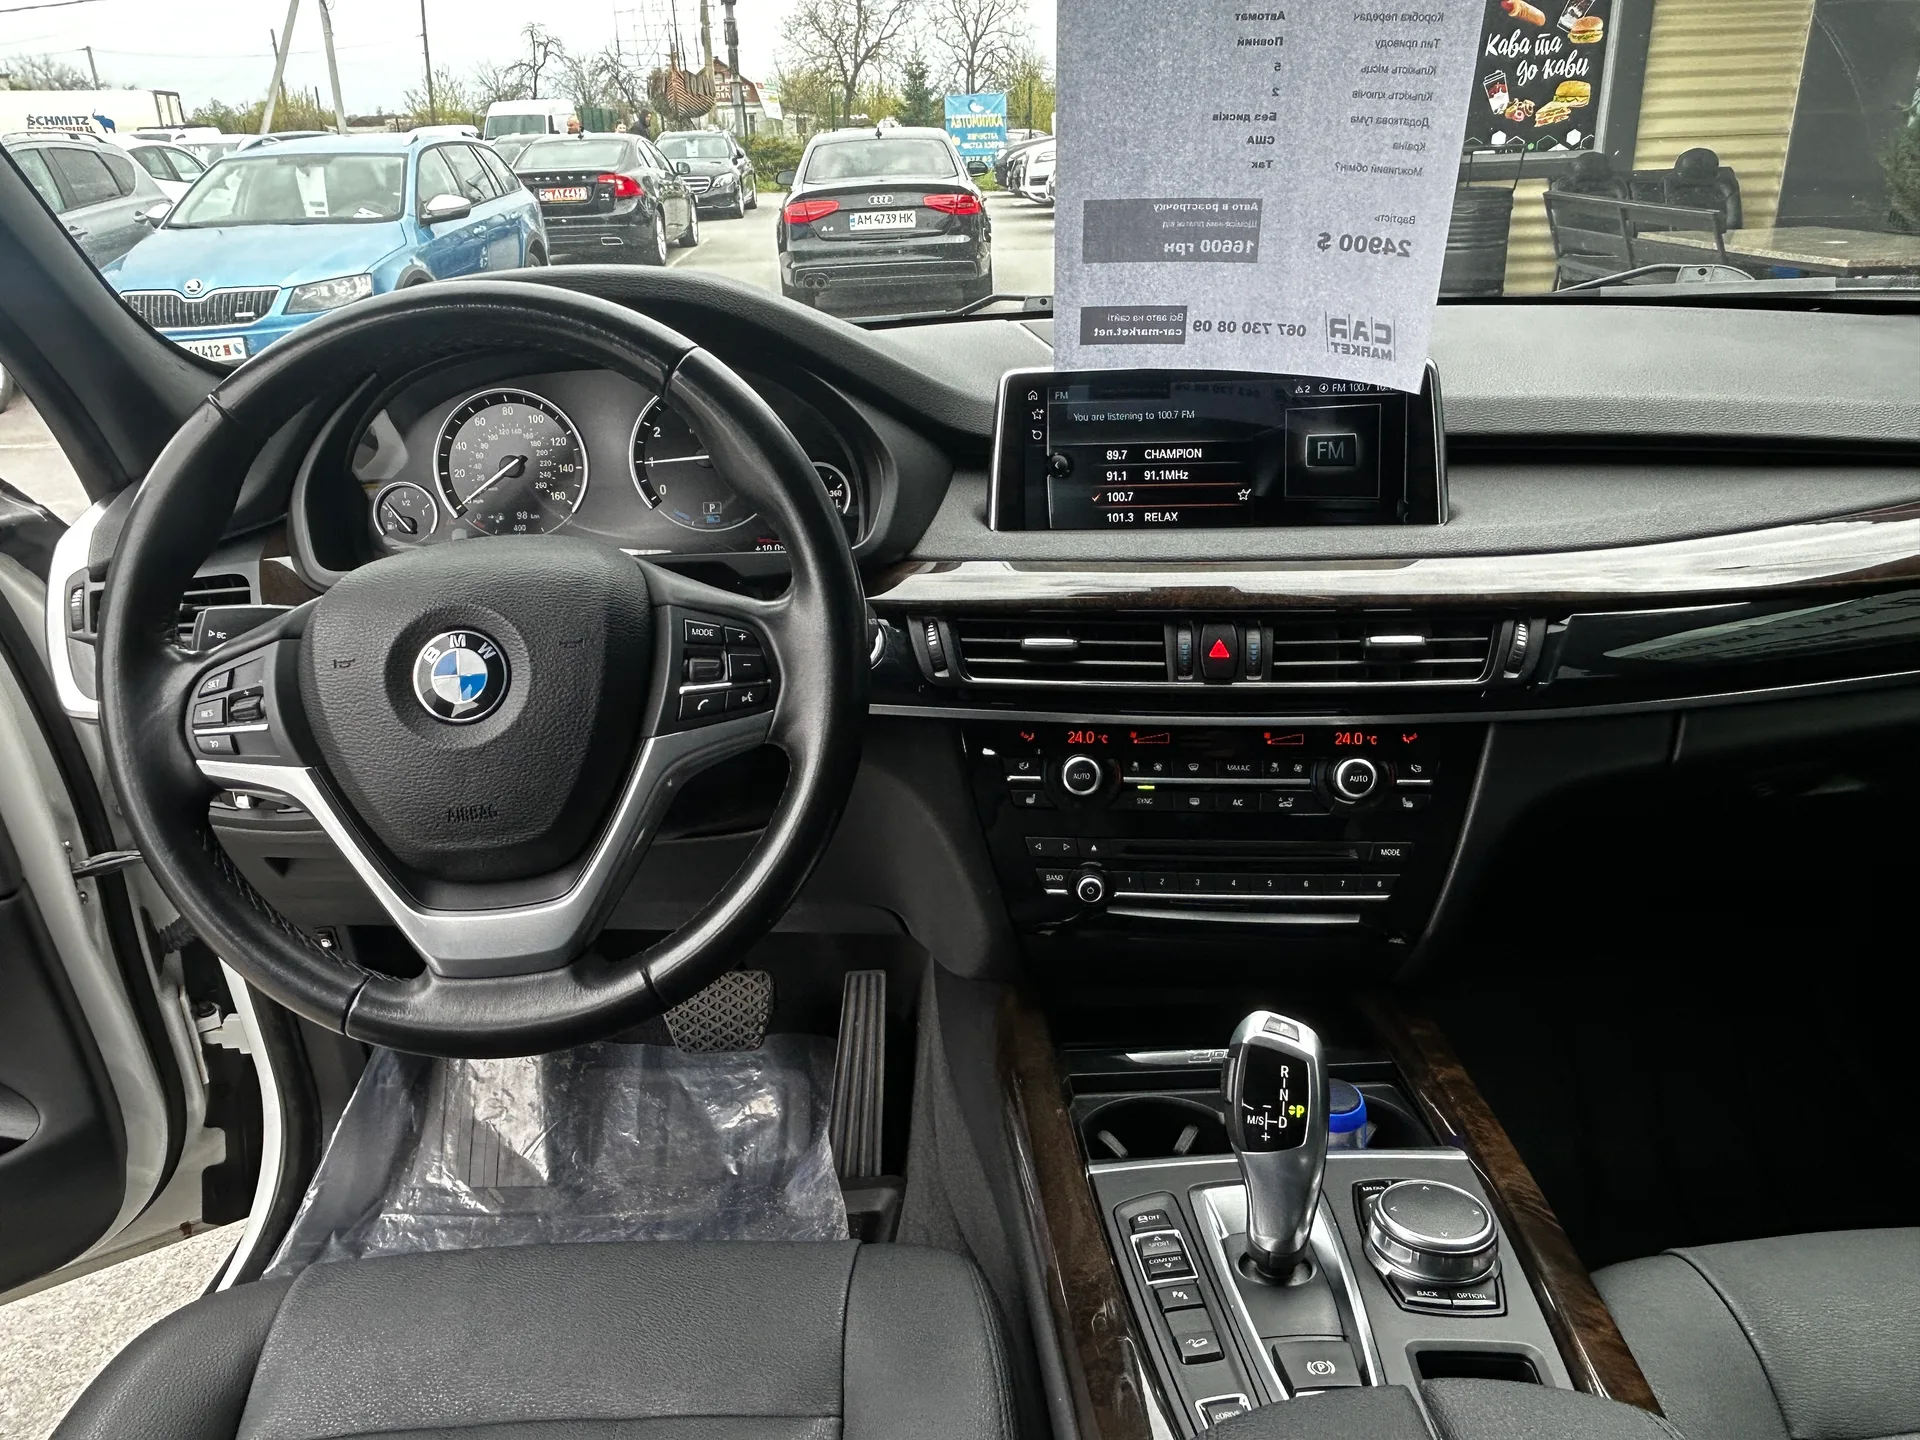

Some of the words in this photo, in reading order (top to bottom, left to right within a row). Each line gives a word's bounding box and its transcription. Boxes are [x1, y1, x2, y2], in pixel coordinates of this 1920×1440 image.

[1485, 28, 1532, 58] Кава
[1534, 33, 1563, 56] та
[1516, 59, 1538, 86] до
[1542, 49, 1589, 80] кави
[26, 114, 89, 127] SCHMITZ
[857, 214, 872, 225] AM
[874, 213, 897, 224] 4739
[899, 212, 913, 223] HK
[1304, 384, 1311, 394] 2
[1332, 383, 1346, 392] FM
[1349, 383, 1371, 392] 100.7
[1054, 391, 1069, 400] FM
[502, 406, 514, 416] 80
[1073, 412, 1089, 422] You
[1107, 411, 1143, 422] listening
[1145, 411, 1155, 420] to
[1157, 410, 1179, 420] 100.7
[1181, 410, 1195, 419] FM
[474, 417, 486, 427] 60
[527, 414, 545, 424] 100
[653, 426, 661, 438] 2
[455, 441, 467, 451] 40
[550, 437, 567, 446] 120
[1106, 450, 1128, 460] 89.7
[1144, 448, 1202, 459] CHAMPION
[1316, 441, 1345, 460] FM
[454, 468, 466, 478] 20
[558, 463, 574, 473] 140
[1106, 471, 1127, 481] 91.1
[1144, 469, 1189, 480] 91.1MHz
[659, 484, 667, 495] 0
[550, 491, 566, 501] 160
[1106, 492, 1134, 502] 100.7
[709, 503, 716, 513] P
[516, 511, 528, 520] 98
[1106, 512, 1134, 523] 101.3
[1144, 512, 1178, 522] RELAX
[691, 628, 714, 637] MODE
[423, 633, 497, 665] BMW
[207, 679, 220, 689] SET
[1068, 731, 1095, 744] 24.0
[1335, 732, 1363, 745] 24.0
[1072, 772, 1091, 780] AUTO
[1349, 775, 1368, 783] AUTO
[1380, 848, 1401, 857] MODE
[1195, 878, 1200, 886] 3
[1267, 879, 1273, 887] 5
[1376, 880, 1382, 888] 8
[1280, 1065, 1289, 1078] R
[1279, 1088, 1289, 1102] N
[1296, 1105, 1305, 1118] P
[1246, 1114, 1265, 1126] M/S
[1278, 1115, 1288, 1129] D
[1456, 1292, 1487, 1300] OPTION
[1316, 1363, 1326, 1372] P
